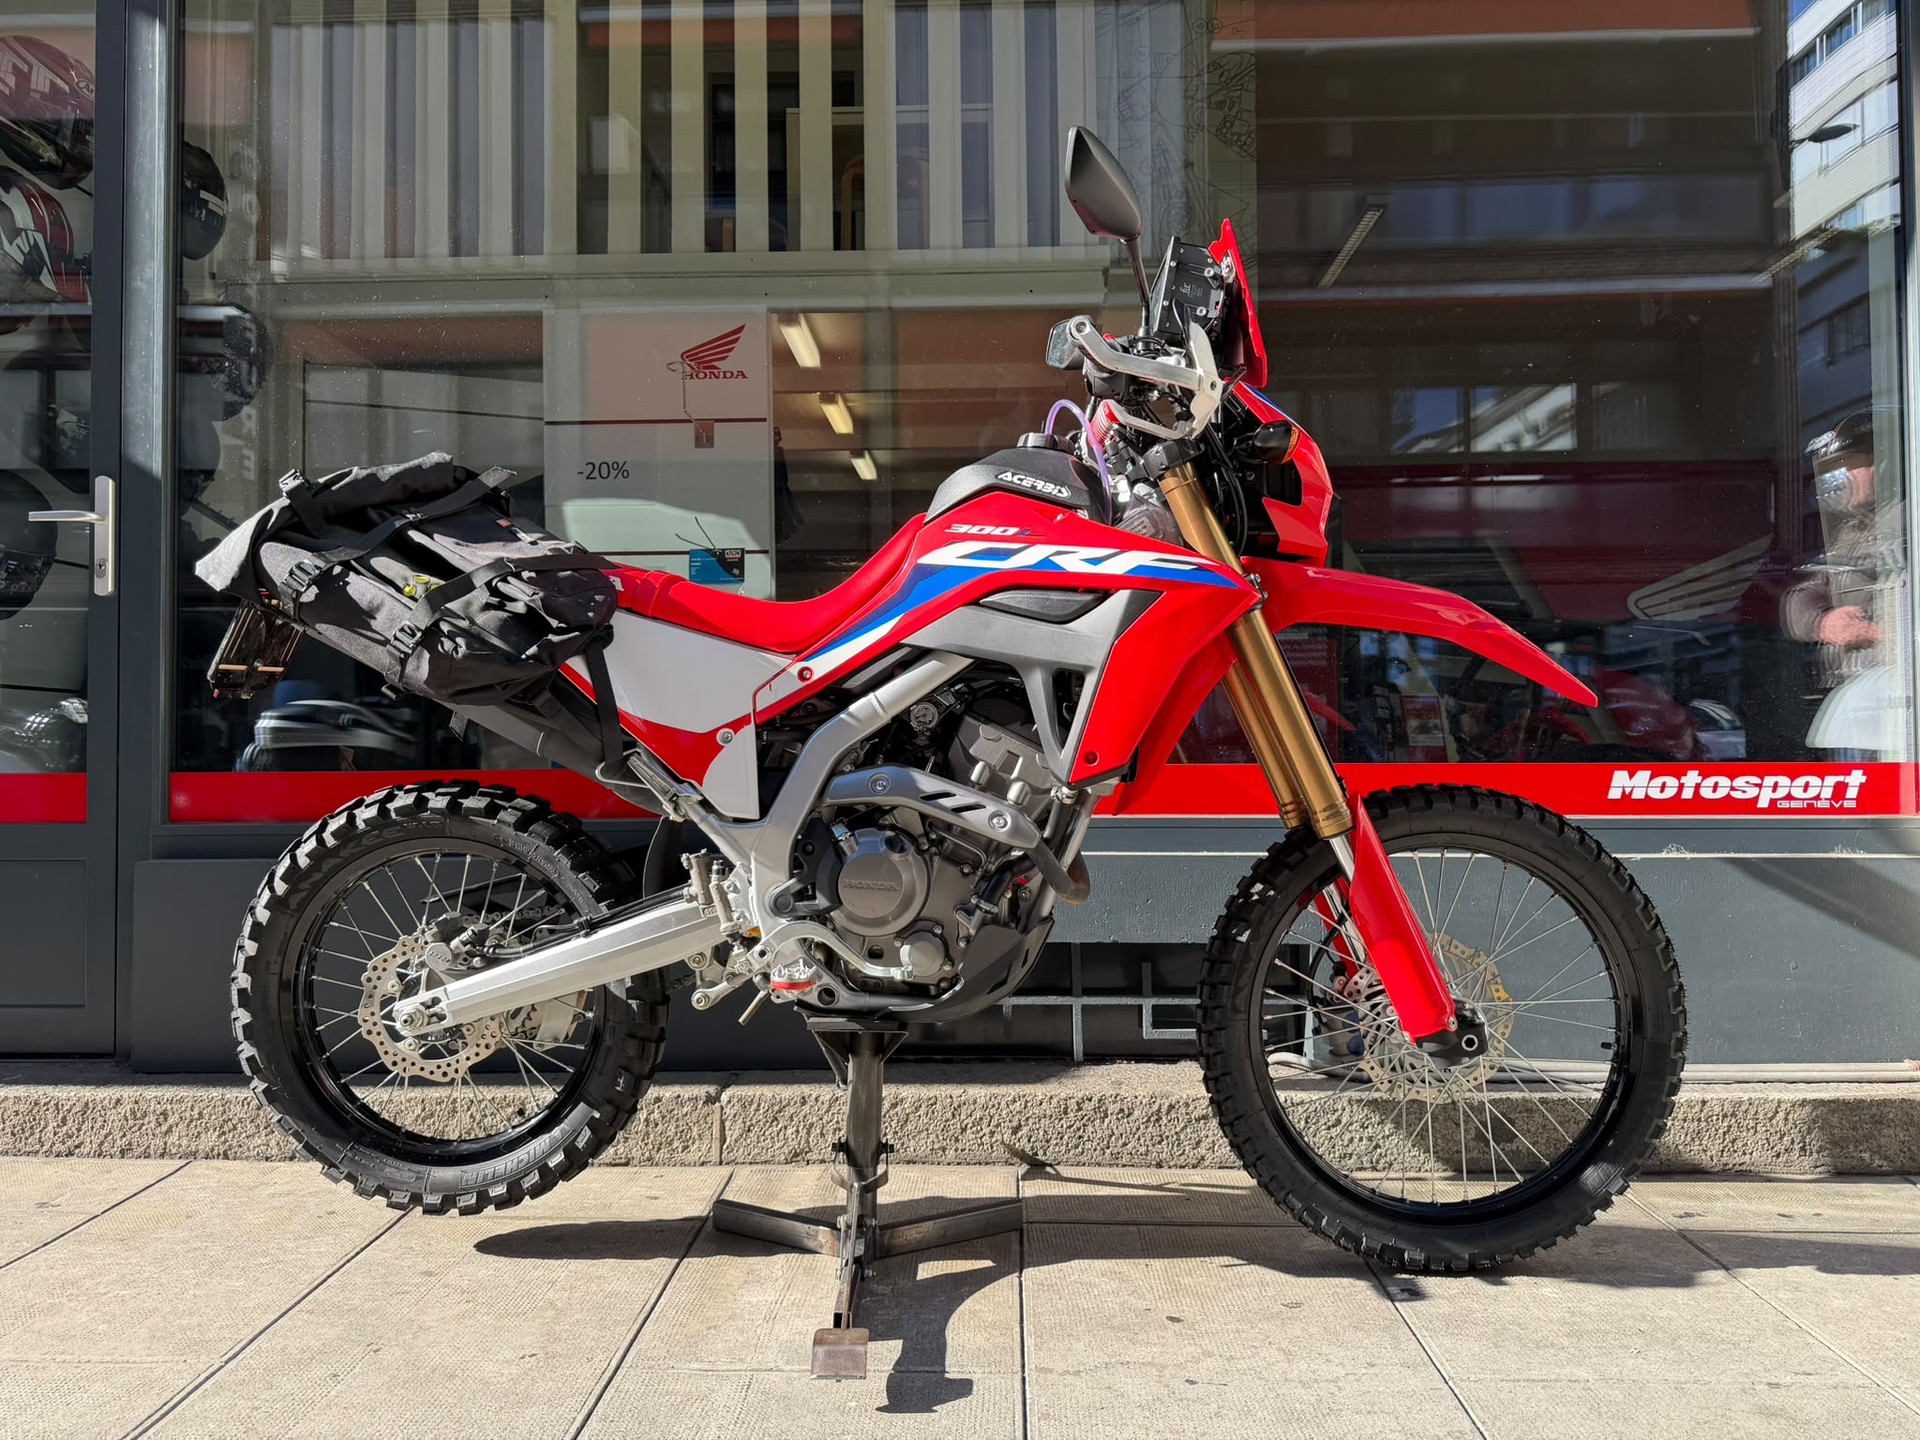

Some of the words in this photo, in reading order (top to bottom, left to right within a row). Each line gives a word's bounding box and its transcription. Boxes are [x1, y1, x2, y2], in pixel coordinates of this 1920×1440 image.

[681, 370, 748, 380] HONDA
[577, 460, 630, 480] -20%
[998, 471, 1072, 498] ACERBIS
[917, 540, 1220, 575] CRF
[1607, 769, 1867, 808] Motosport
[1777, 798, 1857, 808] GENÈVE
[842, 879, 900, 891] HONDA
[462, 1137, 551, 1186] MICHELIN
